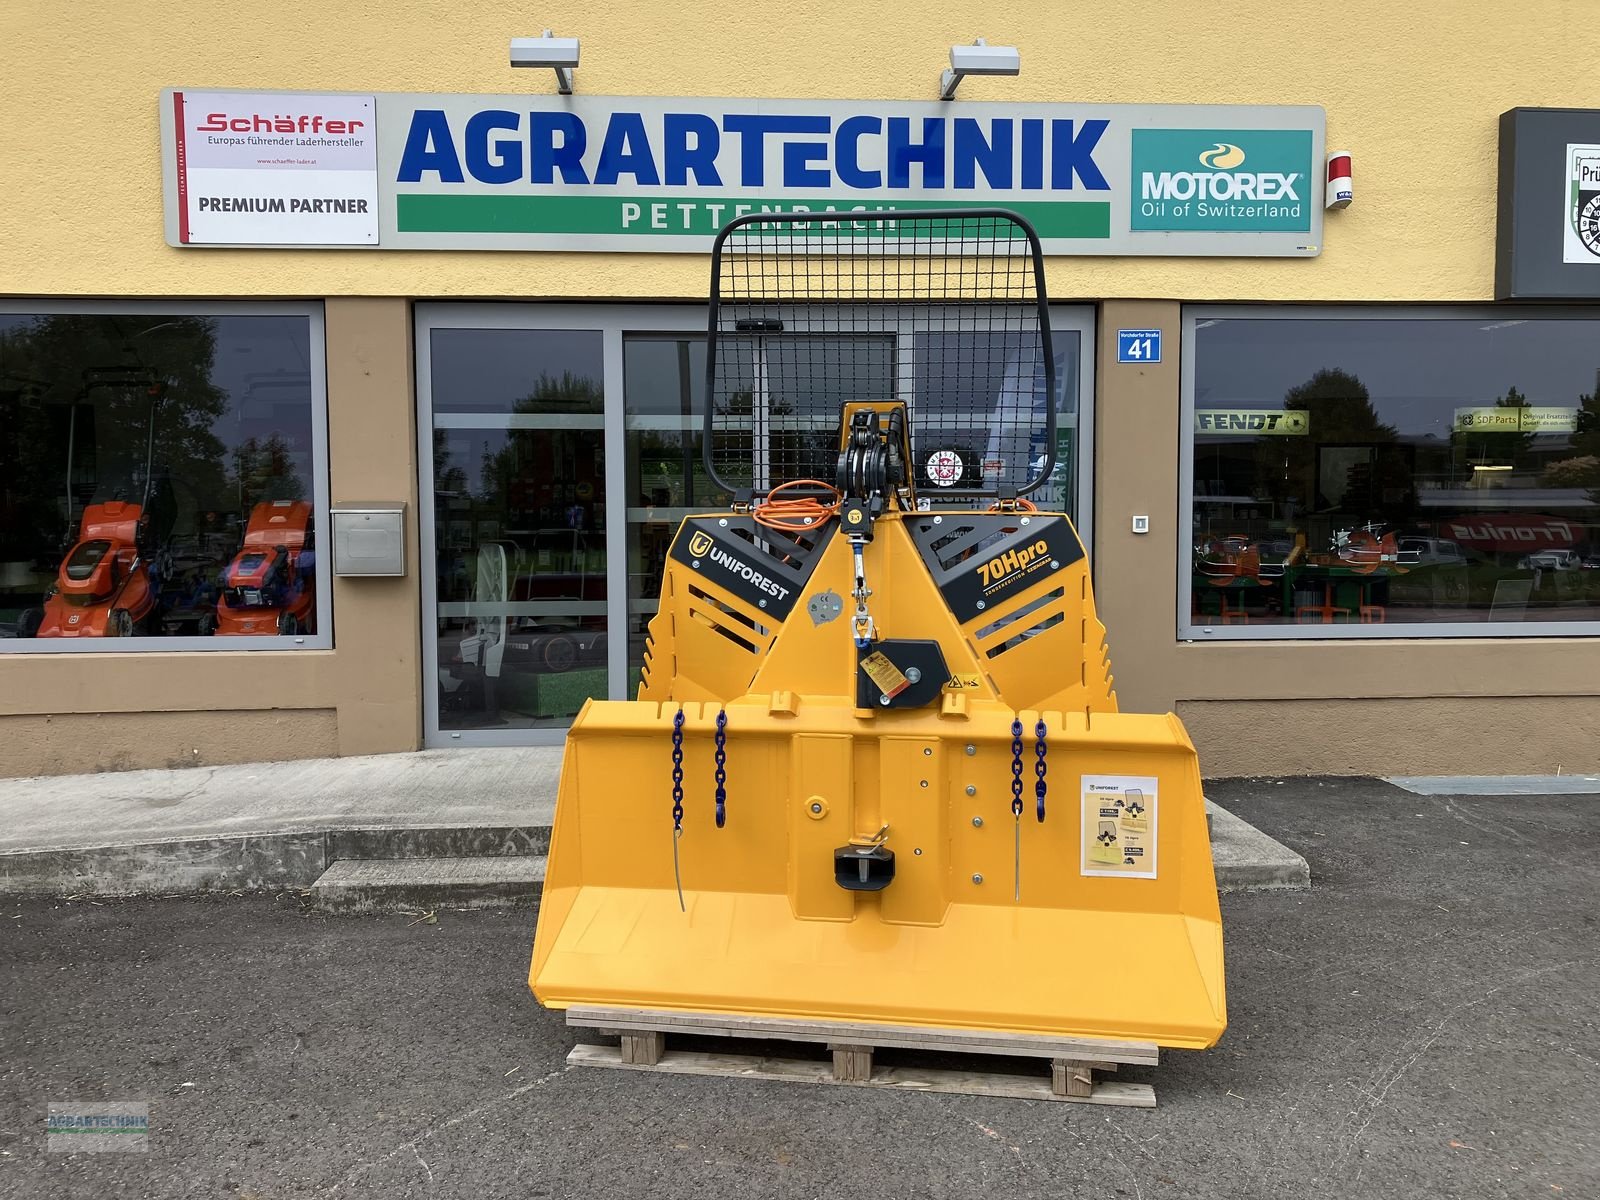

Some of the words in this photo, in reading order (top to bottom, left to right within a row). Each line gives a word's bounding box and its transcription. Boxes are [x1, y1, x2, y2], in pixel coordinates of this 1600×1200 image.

[197, 113, 364, 134] Schäffer
[208, 136, 245, 146] Europas
[247, 136, 293, 146] führender
[296, 137, 364, 147] Laderhersteller
[396, 108, 1111, 190] AGRARTECHNIK
[1141, 171, 1300, 201] MOTOREX
[198, 197, 286, 213] PREMIUM
[290, 198, 368, 214] PARTNER
[1141, 202, 1165, 217] Oil
[1173, 202, 1190, 217] of
[1197, 202, 1300, 218] Switzerland
[621, 202, 896, 231] PETTENBACH
[1128, 339, 1151, 359] 41
[1198, 414, 1283, 430] FENDT
[1477, 415, 1494, 424] SDF
[1495, 415, 1517, 424] Parts
[709, 546, 789, 601] UNIFOREST
[976, 540, 1048, 587] 70Hpro
